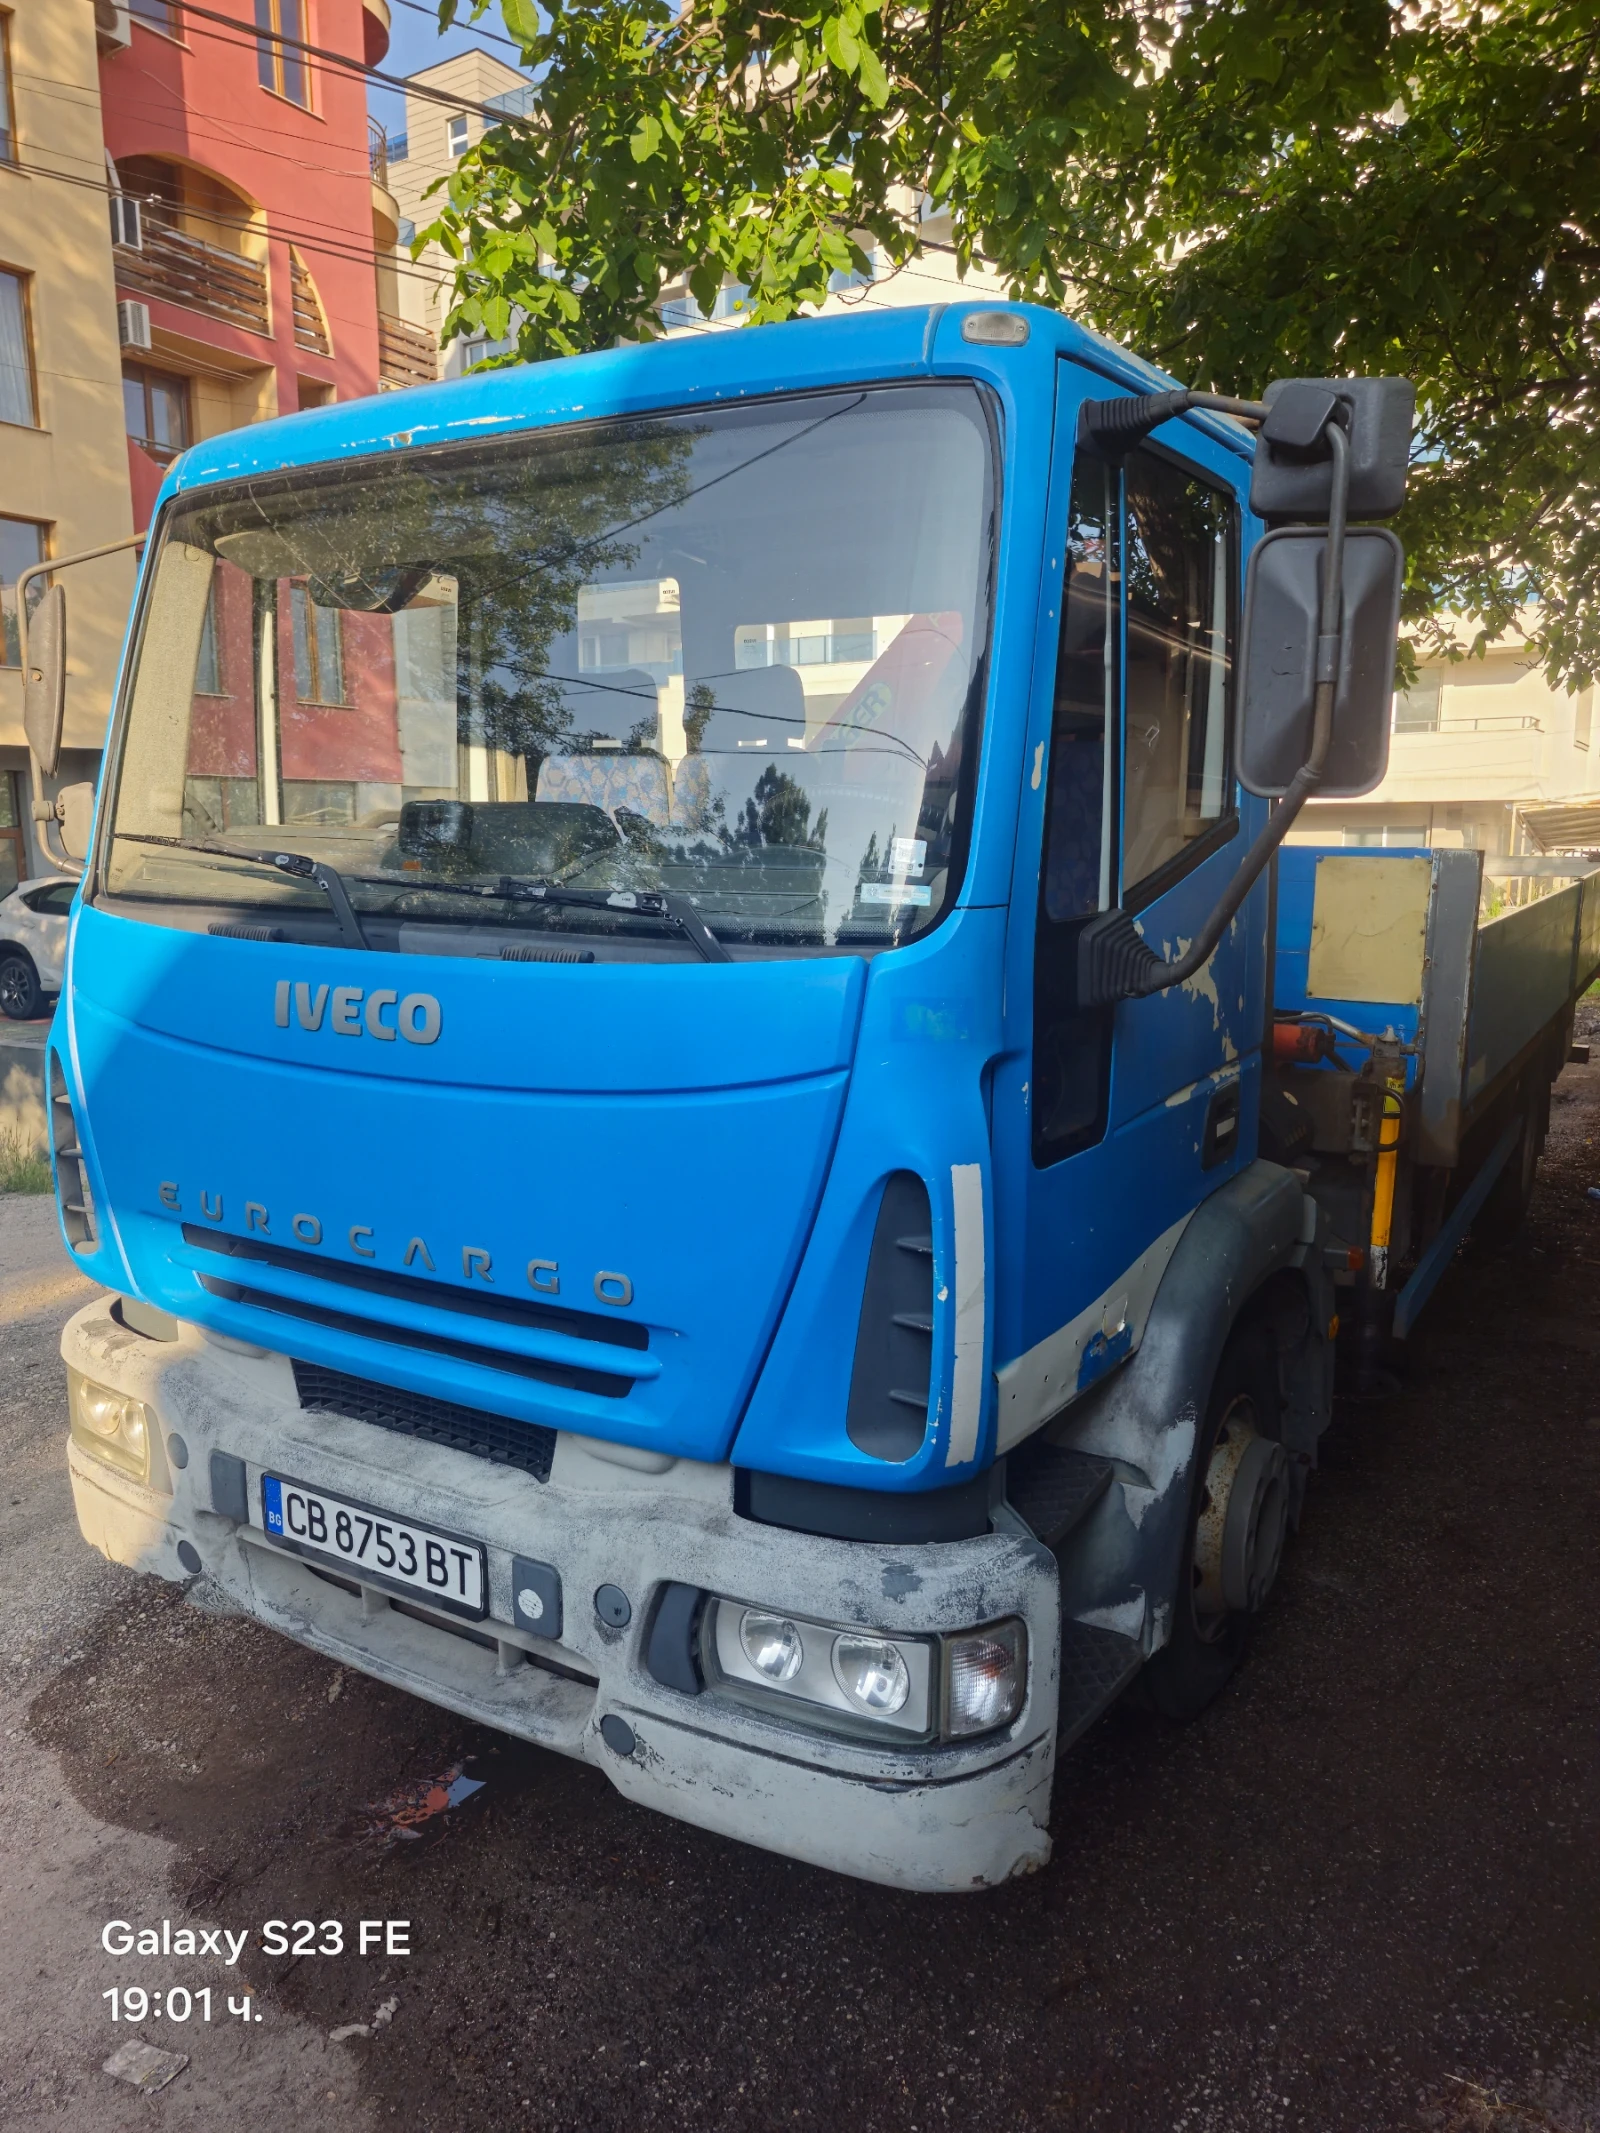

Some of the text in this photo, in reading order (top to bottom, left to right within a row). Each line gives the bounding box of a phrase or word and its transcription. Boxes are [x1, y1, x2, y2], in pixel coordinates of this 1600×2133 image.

[274, 980, 443, 1045] IVECO
[157, 1180, 635, 1307] EUROCARGO
[268, 1510, 282, 1527] BG
[286, 1492, 473, 1596] CB 8753 BT
